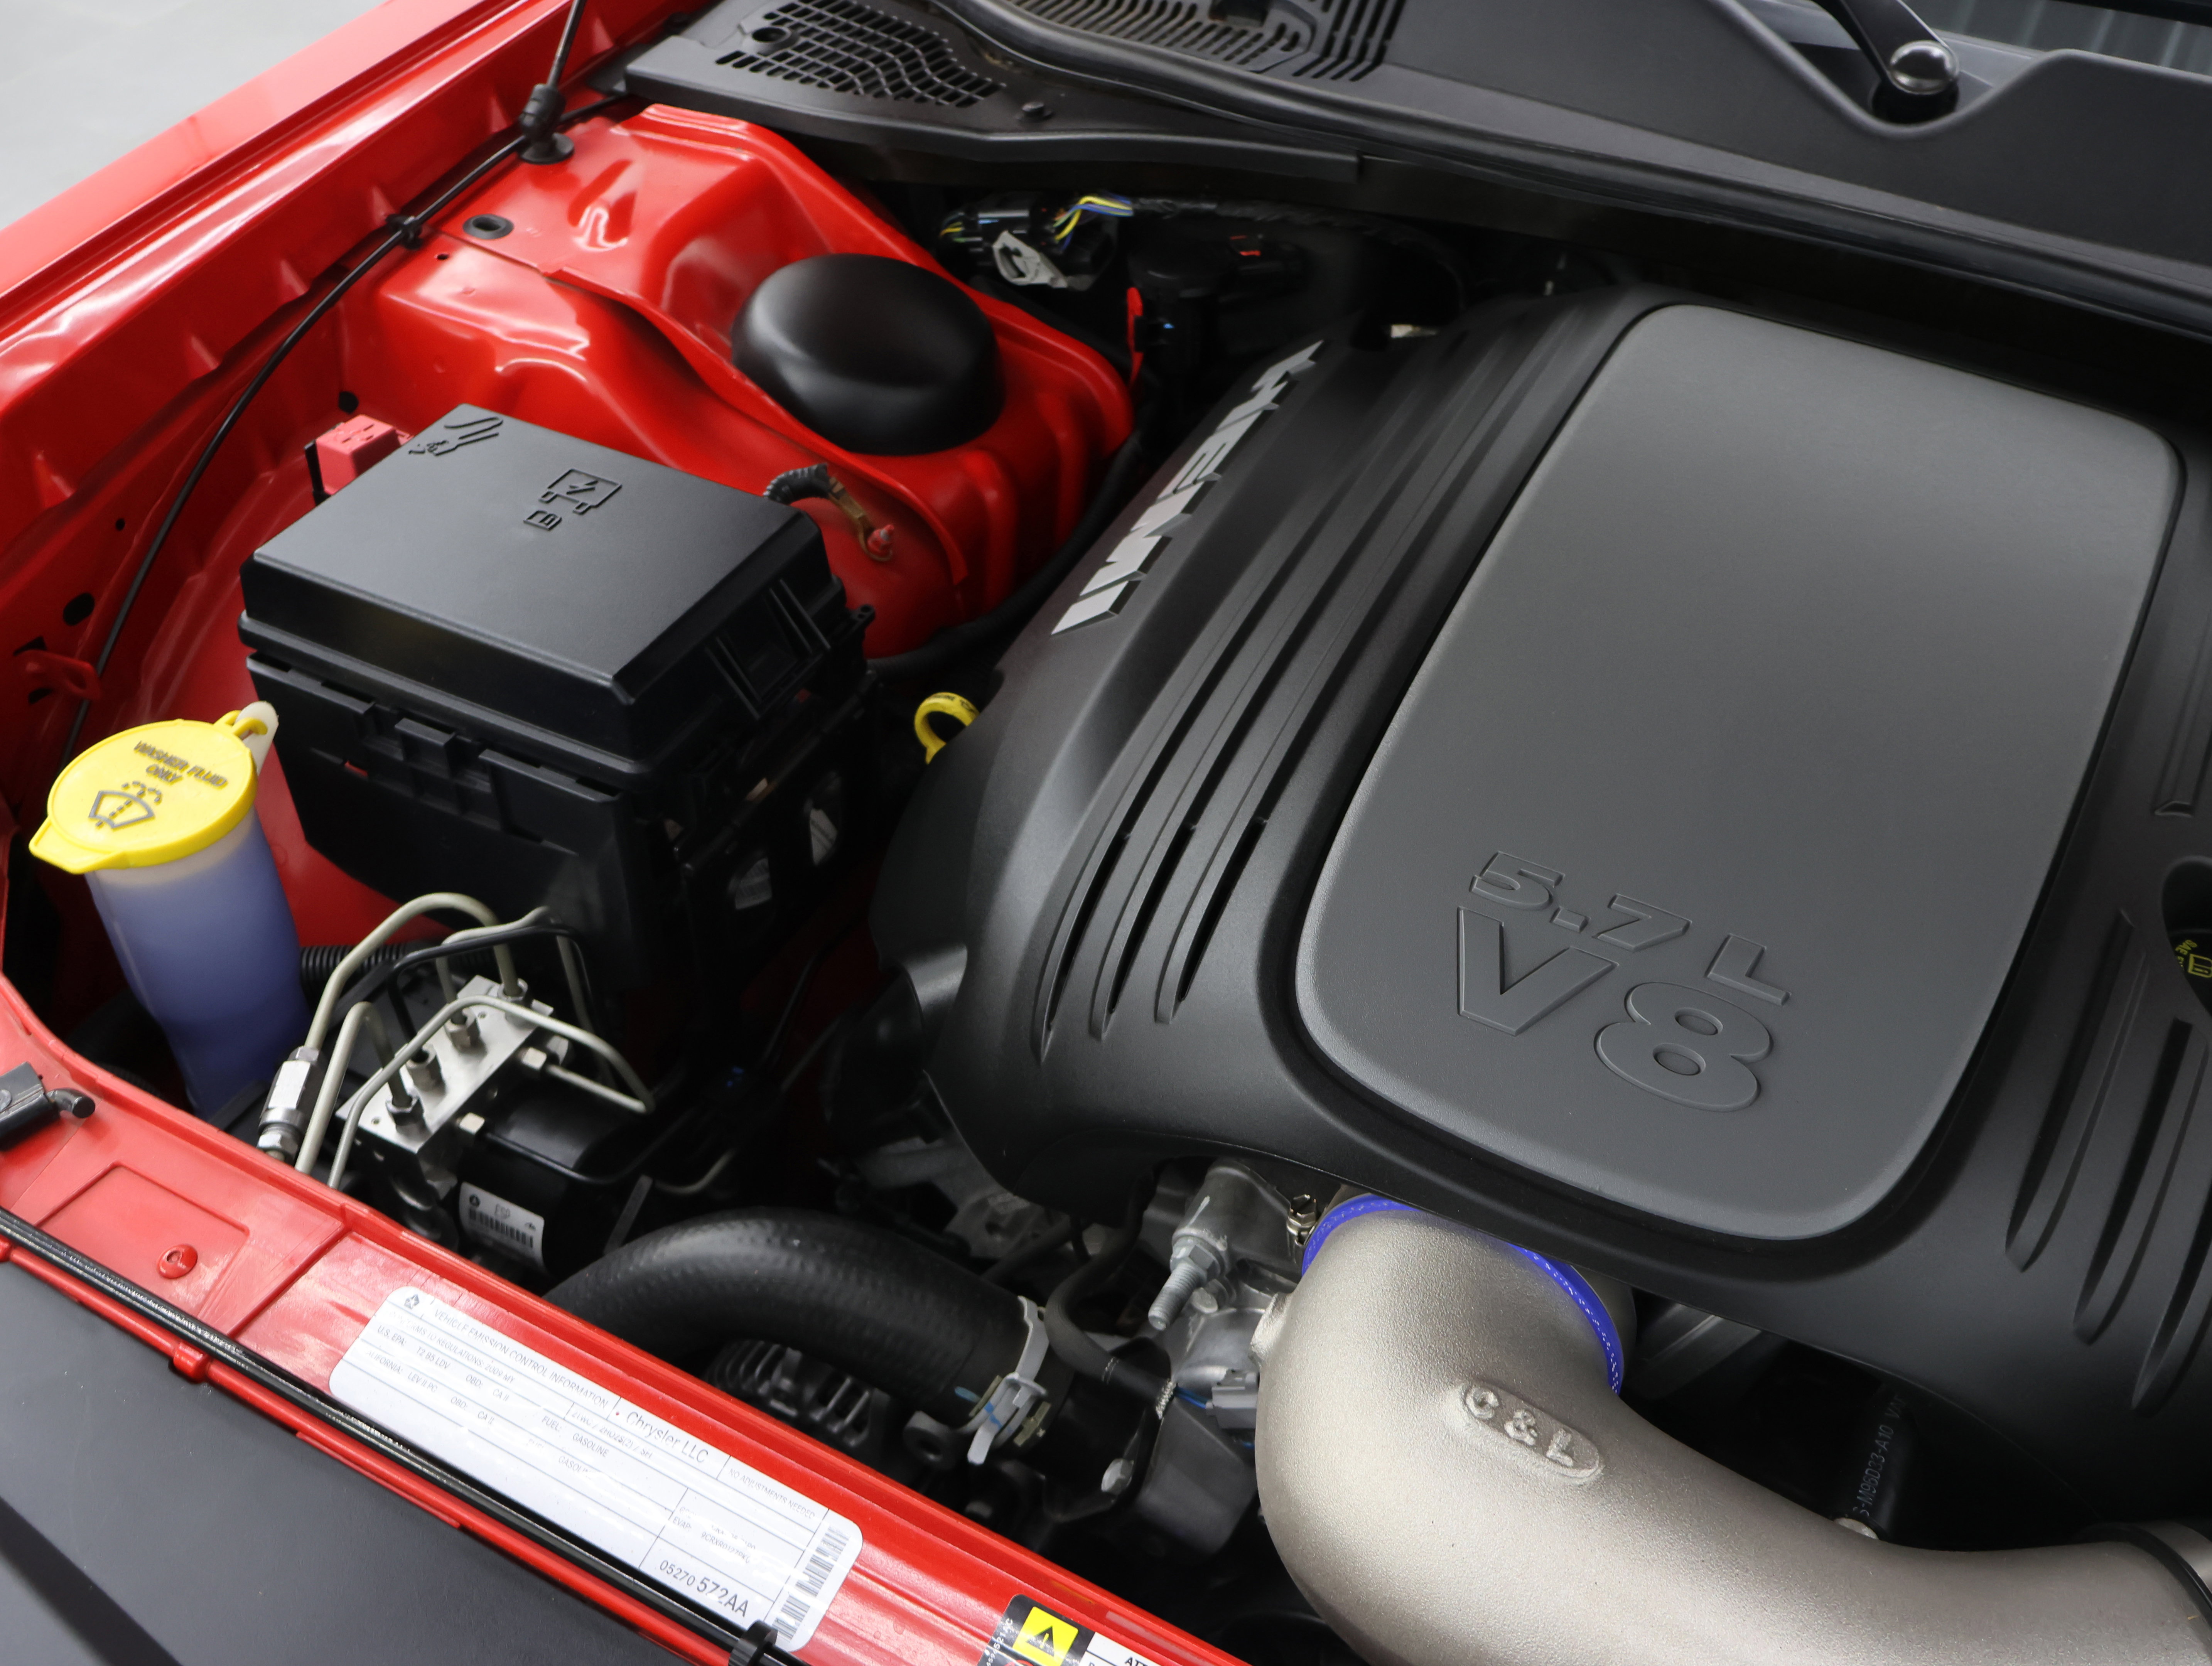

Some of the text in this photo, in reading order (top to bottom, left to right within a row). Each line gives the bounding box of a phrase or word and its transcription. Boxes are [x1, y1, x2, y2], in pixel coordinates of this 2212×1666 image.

[1051, 339, 1324, 635] HEMI
[133, 740, 228, 789] WASHER FLUID
[146, 764, 182, 784] ONLY
[1457, 906, 1773, 1112] V8
[427, 1332, 437, 1341] TO
[436, 1337, 484, 1368] REGULATIONS:
[484, 1364, 503, 1377] 2009
[502, 1373, 515, 1383] MY
[434, 1308, 609, 1409] VEHICLE EMISSION CONTROL INFORMATION
[365, 1349, 403, 1374] ALIFORNIA:
[407, 1371, 423, 1384] LEV
[426, 1381, 438, 1392] PC
[450, 1396, 468, 1410] OBD:
[477, 1410, 488, 1421] CA
[557, 1455, 594, 1479] GASOLI
[377, 1324, 390, 1338] U.S.
[390, 1332, 407, 1346] EPA:
[416, 1346, 426, 1357] T2
[425, 1351, 435, 1362] B5
[434, 1357, 451, 1369] LDV
[465, 1374, 483, 1388] OBD:
[492, 1388, 503, 1399] CA
[541, 1415, 562, 1432] FUEL:
[572, 1432, 609, 1457] GASOLINE
[626, 1411, 709, 1463] Chrysler LLC
[729, 1467, 815, 1519] NO ADJUSTMENTS NEEDED
[672, 1516, 693, 1530] EVAP:
[659, 1559, 749, 1618] 05270 572AA
